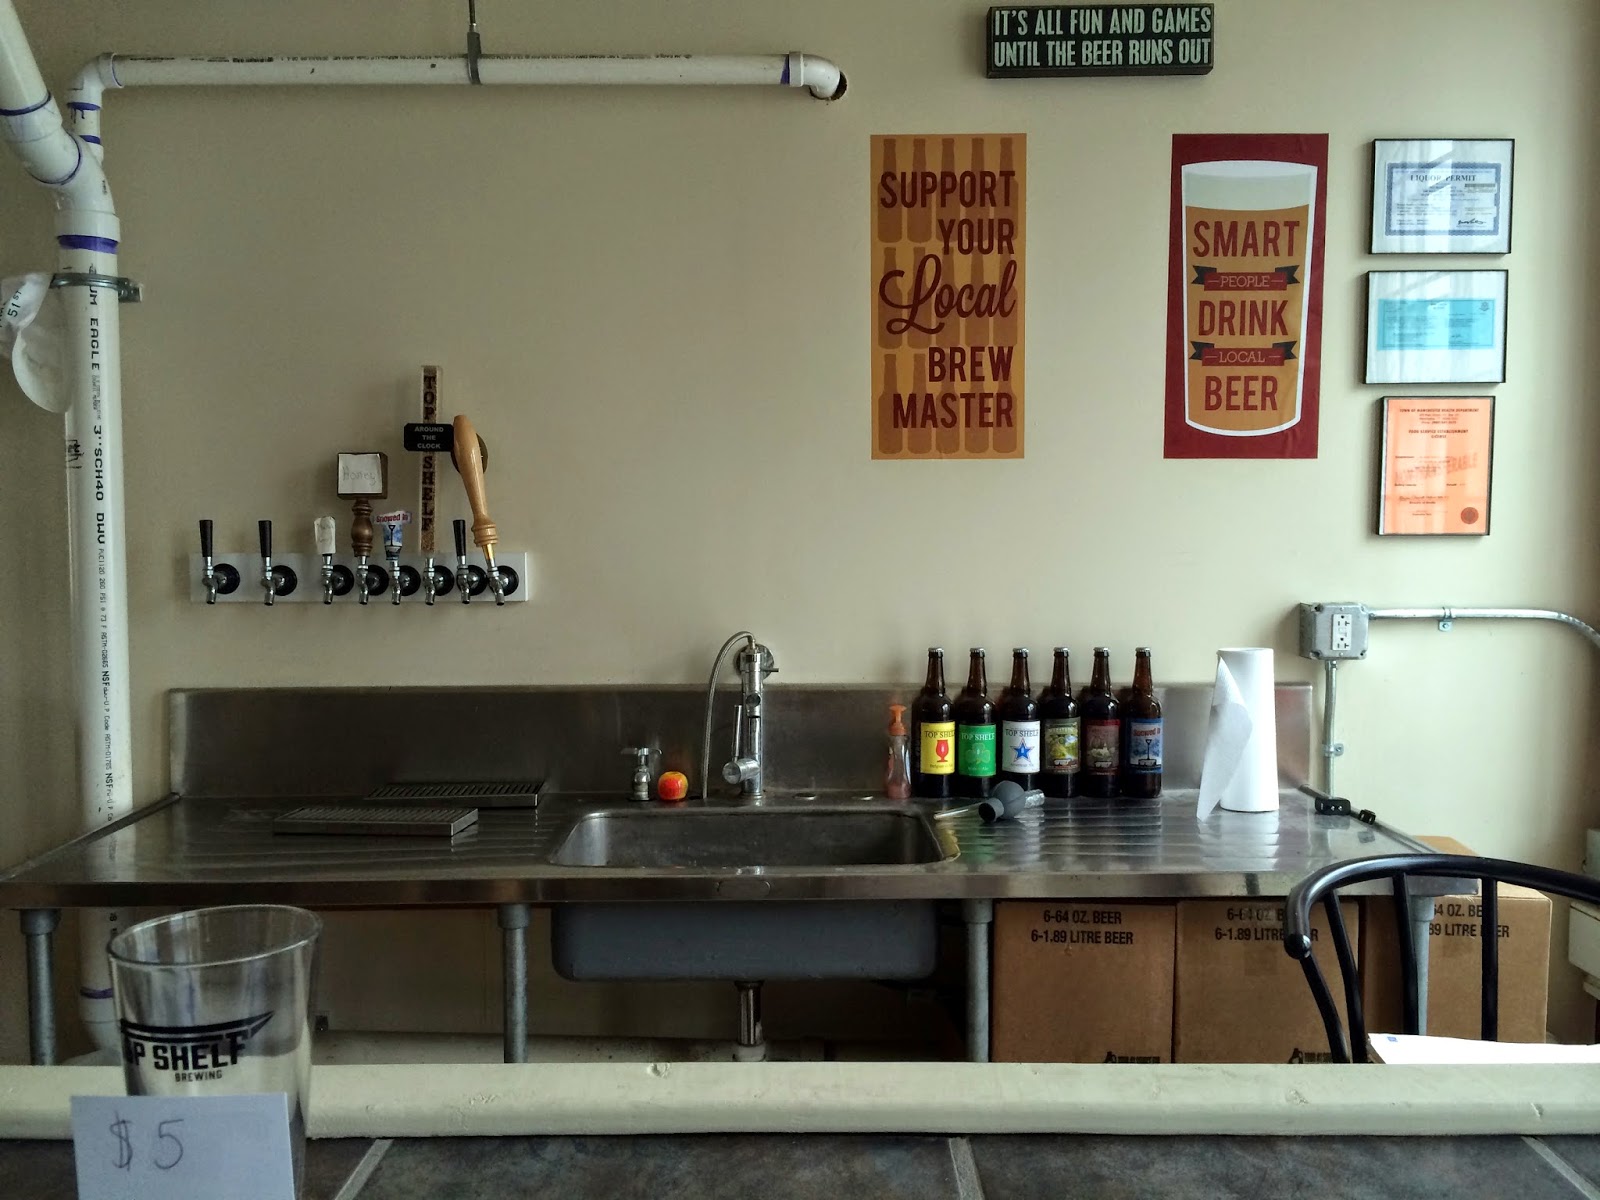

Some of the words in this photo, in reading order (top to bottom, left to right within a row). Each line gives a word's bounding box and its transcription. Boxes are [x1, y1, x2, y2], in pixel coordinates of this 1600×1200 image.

[995, 9, 1028, 36] IT'S
[1035, 9, 1064, 35] ALL
[1070, 9, 1103, 35] FUN
[1109, 8, 1144, 34] AND
[1152, 7, 1211, 34] GAMES
[994, 41, 1040, 67] UNTIL
[1046, 40, 1076, 66] THE
[1081, 40, 1123, 66] BEER
[1128, 39, 1173, 65] RUNS
[1178, 38, 1211, 64] OUT
[880, 170, 1016, 209] SUPPORT
[937, 218, 1015, 256] YOUR
[1192, 220, 1300, 258] SMART
[878, 253, 1018, 335] Local
[1219, 275, 1271, 288] PEOPLE
[1198, 299, 1289, 336] DRINK
[928, 346, 1014, 382] BREW
[1219, 351, 1266, 363] LOCAL
[423, 375, 436, 420] TOP
[1204, 375, 1278, 411] BEER
[892, 392, 1013, 429] MASTER
[90, 317, 100, 371] EAGLE
[96, 512, 105, 544] DWV
[421, 456, 435, 531] SHELF
[961, 732, 973, 740] TOP
[974, 733, 995, 741] SHELF
[1005, 729, 1017, 737] TOP
[1043, 910, 1069, 923] 6-64
[1072, 910, 1090, 924] OZ.
[1093, 911, 1122, 924] BEER
[1447, 903, 1465, 917] OZ.
[1031, 929, 1067, 943] 6-1.89
[1070, 930, 1101, 944] LITRE
[1104, 931, 1134, 945] BEER
[1215, 927, 1252, 941] 6-1.89
[1254, 928, 1284, 941] LITRE
[1444, 923, 1477, 937] LITRE
[152, 1028, 249, 1071] SHELF
[174, 1070, 223, 1083] BREWING
